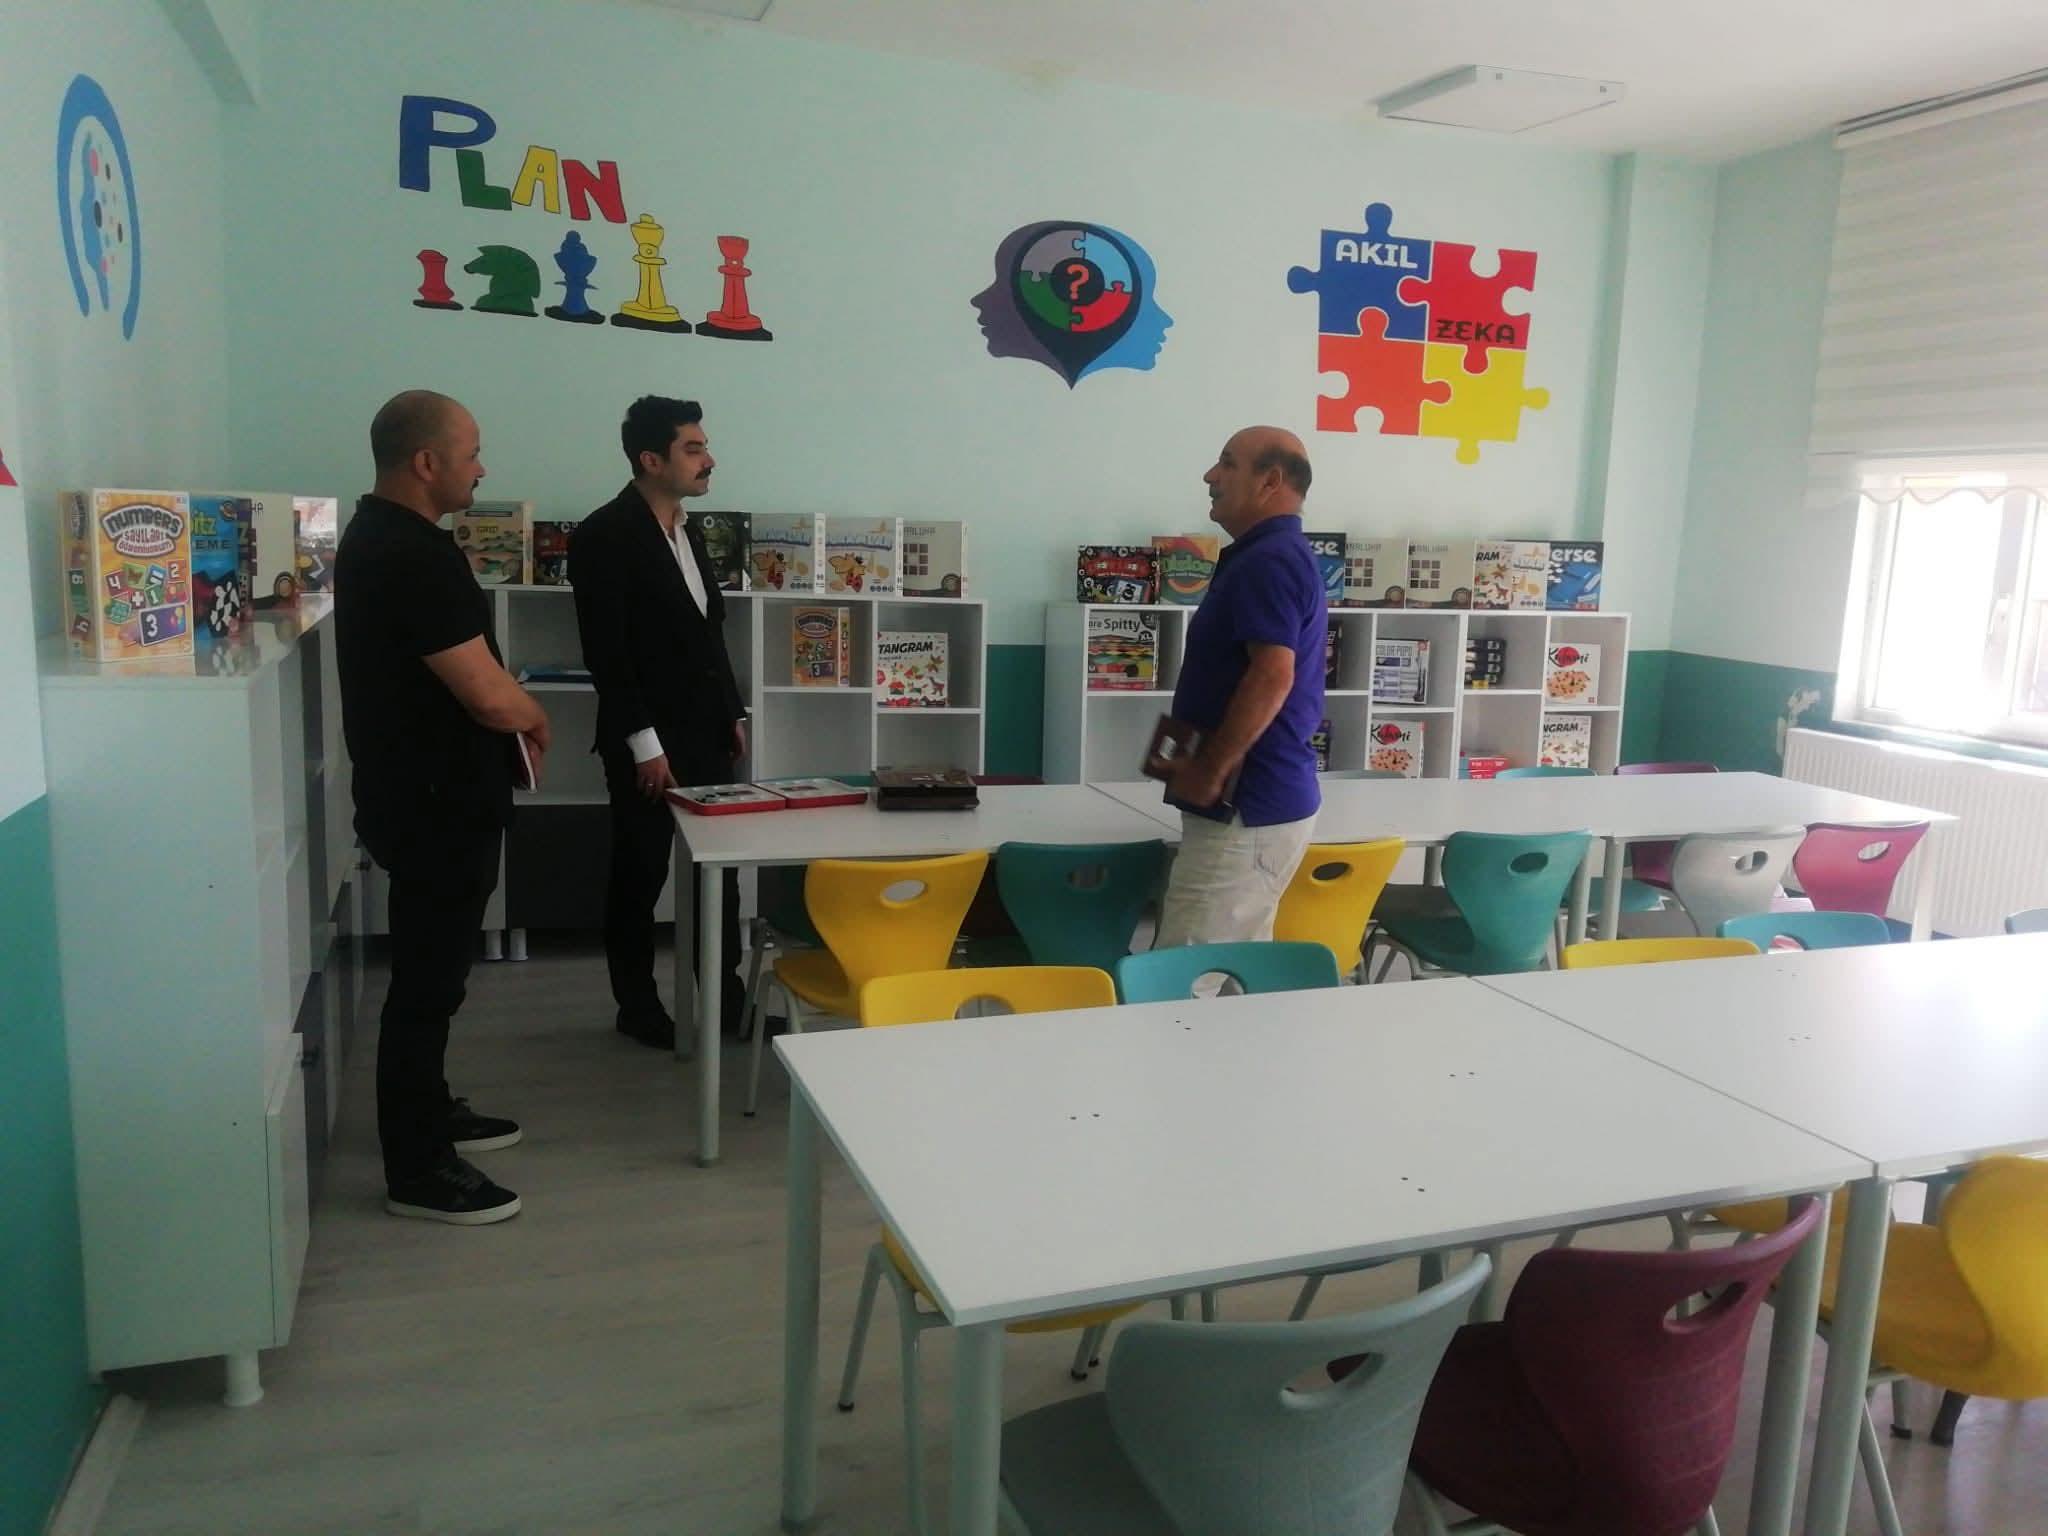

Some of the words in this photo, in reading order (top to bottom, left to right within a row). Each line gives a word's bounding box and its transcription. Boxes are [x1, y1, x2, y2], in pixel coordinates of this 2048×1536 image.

[399, 95, 627, 223] PLAN
[1335, 239, 1418, 269] AKIL
[1435, 319, 1516, 345] ZEKA
[146, 613, 159, 637] 3
[1103, 618, 1140, 632] Spitty
[1141, 632, 1153, 641] XL
[878, 641, 933, 655] TANGRAM
